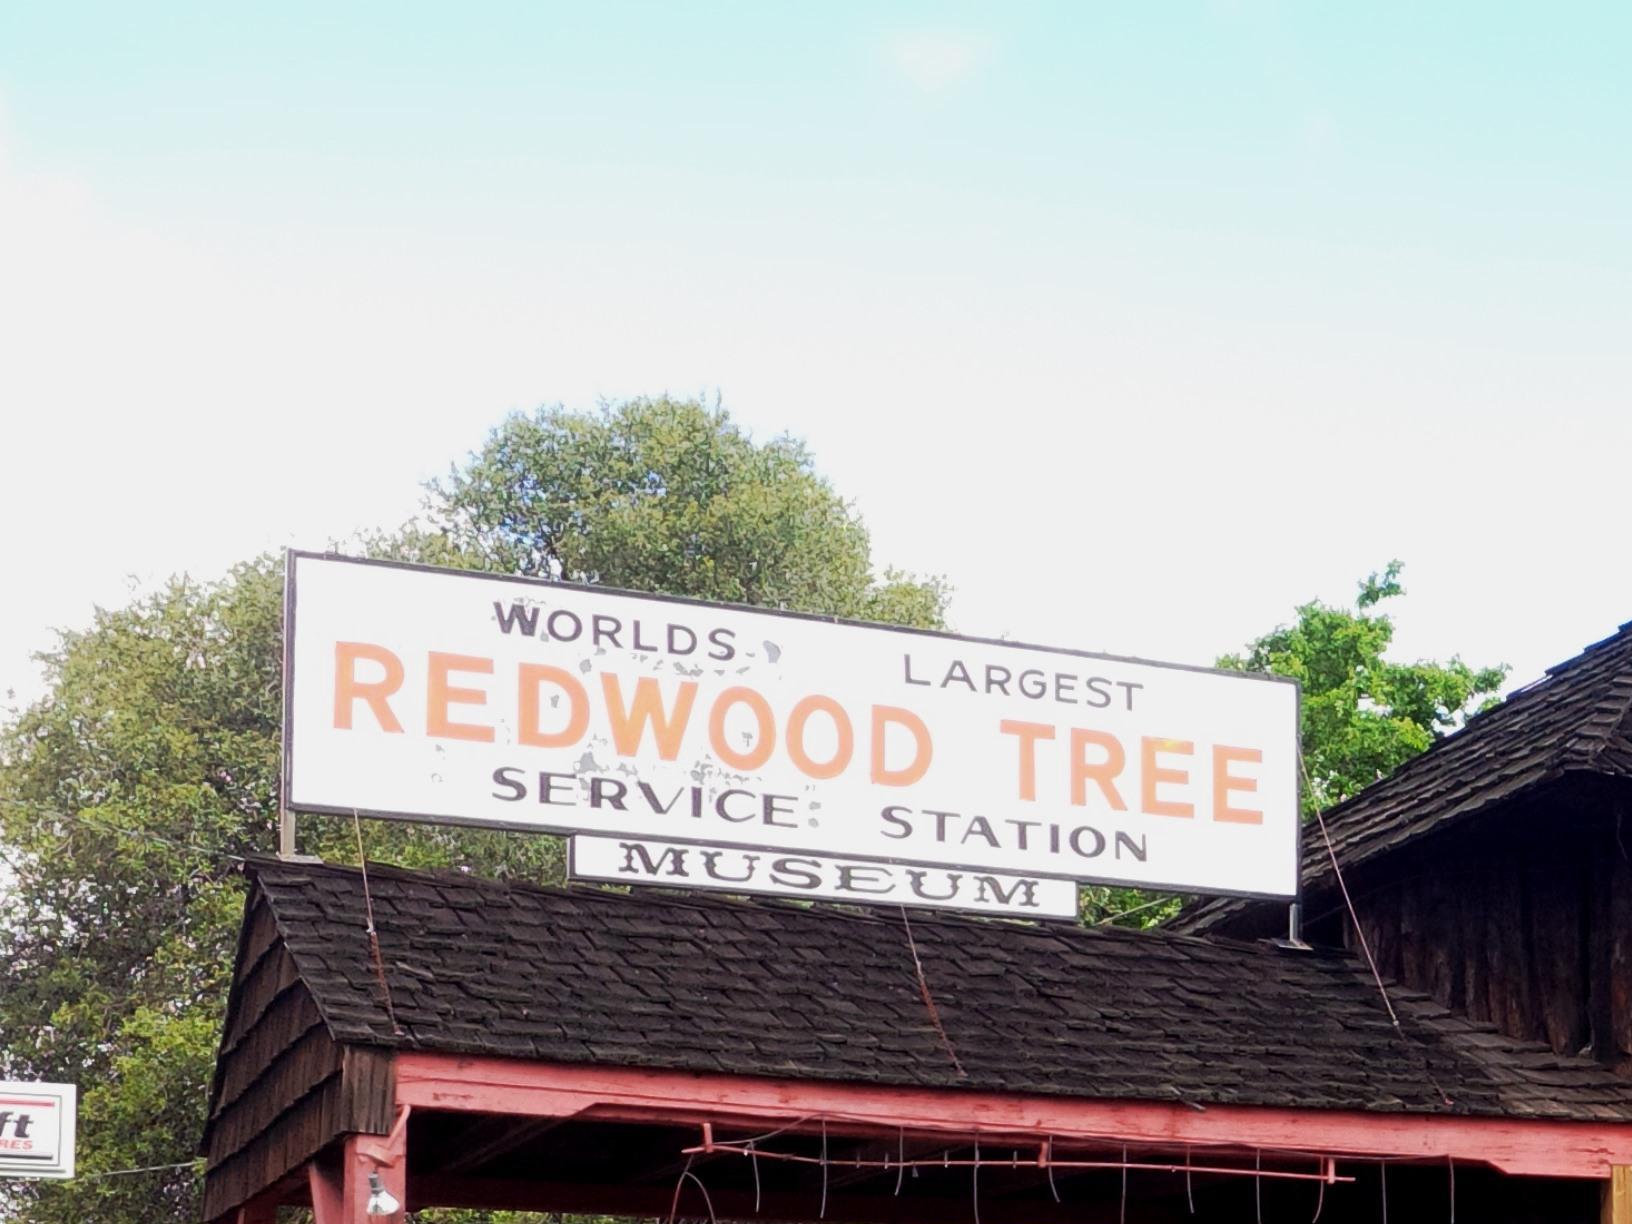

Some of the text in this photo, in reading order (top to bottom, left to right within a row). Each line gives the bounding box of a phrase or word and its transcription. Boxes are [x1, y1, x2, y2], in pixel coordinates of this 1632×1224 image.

[493, 600, 1144, 711] WORLDS LARGEST
[333, 640, 1263, 825] REDWOOD TREE
[492, 766, 1147, 862] SERVICE STATION
[618, 842, 1041, 908] MUSEUM
